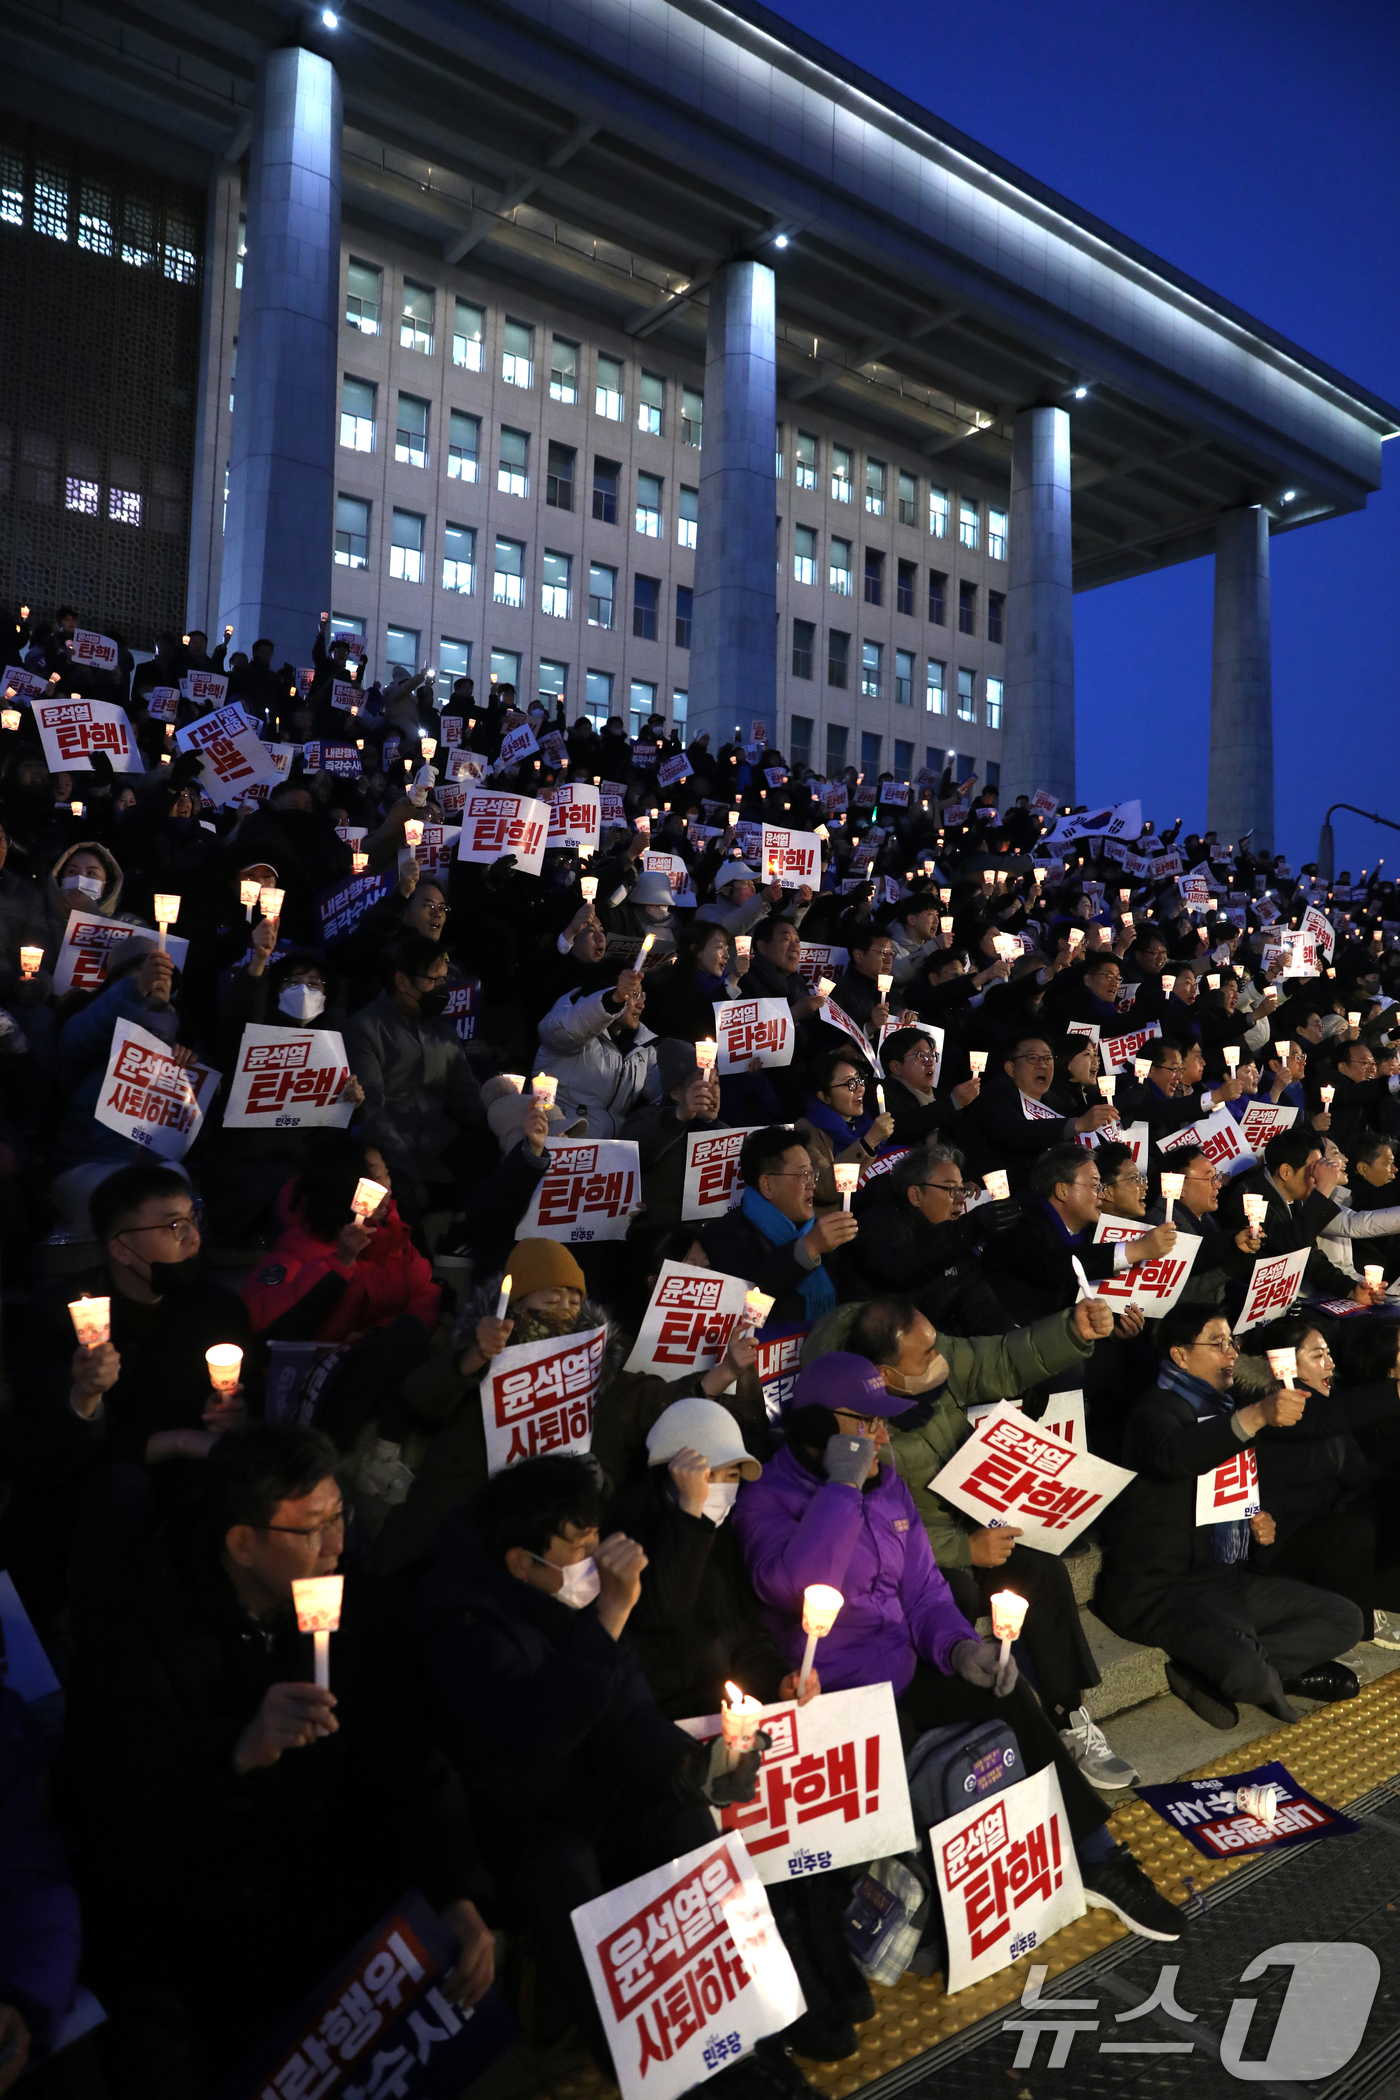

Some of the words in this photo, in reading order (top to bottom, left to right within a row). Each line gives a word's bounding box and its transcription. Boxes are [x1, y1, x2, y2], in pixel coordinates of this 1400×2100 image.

[78, 643, 115, 661] 탄핵!
[193, 683, 224, 698] 탄핵!
[44, 705, 90, 726] 윤석열
[217, 708, 245, 737] 윤석열
[56, 723, 128, 760] 탄핵!
[187, 720, 255, 783] 탄핵!
[306, 744, 320, 753] 윤석
[502, 732, 530, 762] 탄핵!
[472, 800, 518, 817] 윤석열
[547, 804, 597, 838] 탄핵!
[472, 817, 543, 854] 탄핵!
[766, 832, 789, 848] 윤석열
[647, 857, 672, 870] 윤석열
[768, 849, 815, 876] 탄핵!
[1155, 859, 1178, 876] 탄핵!
[320, 875, 382, 920] 내란행위
[670, 872, 689, 894] 핵!
[1184, 880, 1208, 891] 윤석열
[324, 888, 387, 939] 즉각수사!
[1187, 893, 1209, 904] 사퇴하
[75, 926, 130, 947] 윤석열
[1308, 923, 1333, 951] 탄핵!
[71, 950, 110, 987] 탄
[800, 949, 828, 962] 윤석열
[720, 1005, 757, 1027] 윤석열
[728, 1018, 786, 1063] 탄핵!
[247, 1045, 307, 1069] 윤석열
[119, 1047, 199, 1099] 윤석열은
[245, 1067, 348, 1114] 탄핵!
[107, 1083, 197, 1134] 사퇴하라!
[275, 1118, 300, 1126] 민주당
[1248, 1111, 1277, 1123] 윤석열
[131, 1127, 153, 1145] 민주당
[695, 1137, 743, 1161] 윤석열
[1203, 1126, 1240, 1165] 핵!
[538, 1171, 634, 1226] 탄핵!
[571, 1231, 594, 1240] 민주당
[1097, 1259, 1187, 1298] 탄핵!
[1256, 1261, 1286, 1287] 윤석열
[659, 1278, 721, 1308] 윤석열
[1246, 1272, 1301, 1322] 탄핵!
[758, 1337, 804, 1378] 내란
[502, 1339, 603, 1418] 윤석열은
[507, 1396, 597, 1464] 사퇴하
[987, 1423, 1071, 1475] 윤석열
[959, 1453, 1103, 1529] 탄핵!
[1245, 1505, 1260, 1517] 민주
[720, 1735, 880, 1857] 탄핵!
[1202, 1803, 1325, 1851] 내란행위
[946, 1807, 1007, 1884] 윤석열
[788, 1851, 832, 1875] 민주당
[963, 1813, 1063, 1961] 탄핵!
[609, 1860, 740, 2005] 윤석열은
[1009, 1930, 1037, 1960] 민주당
[702, 2031, 742, 2070] 민주당
